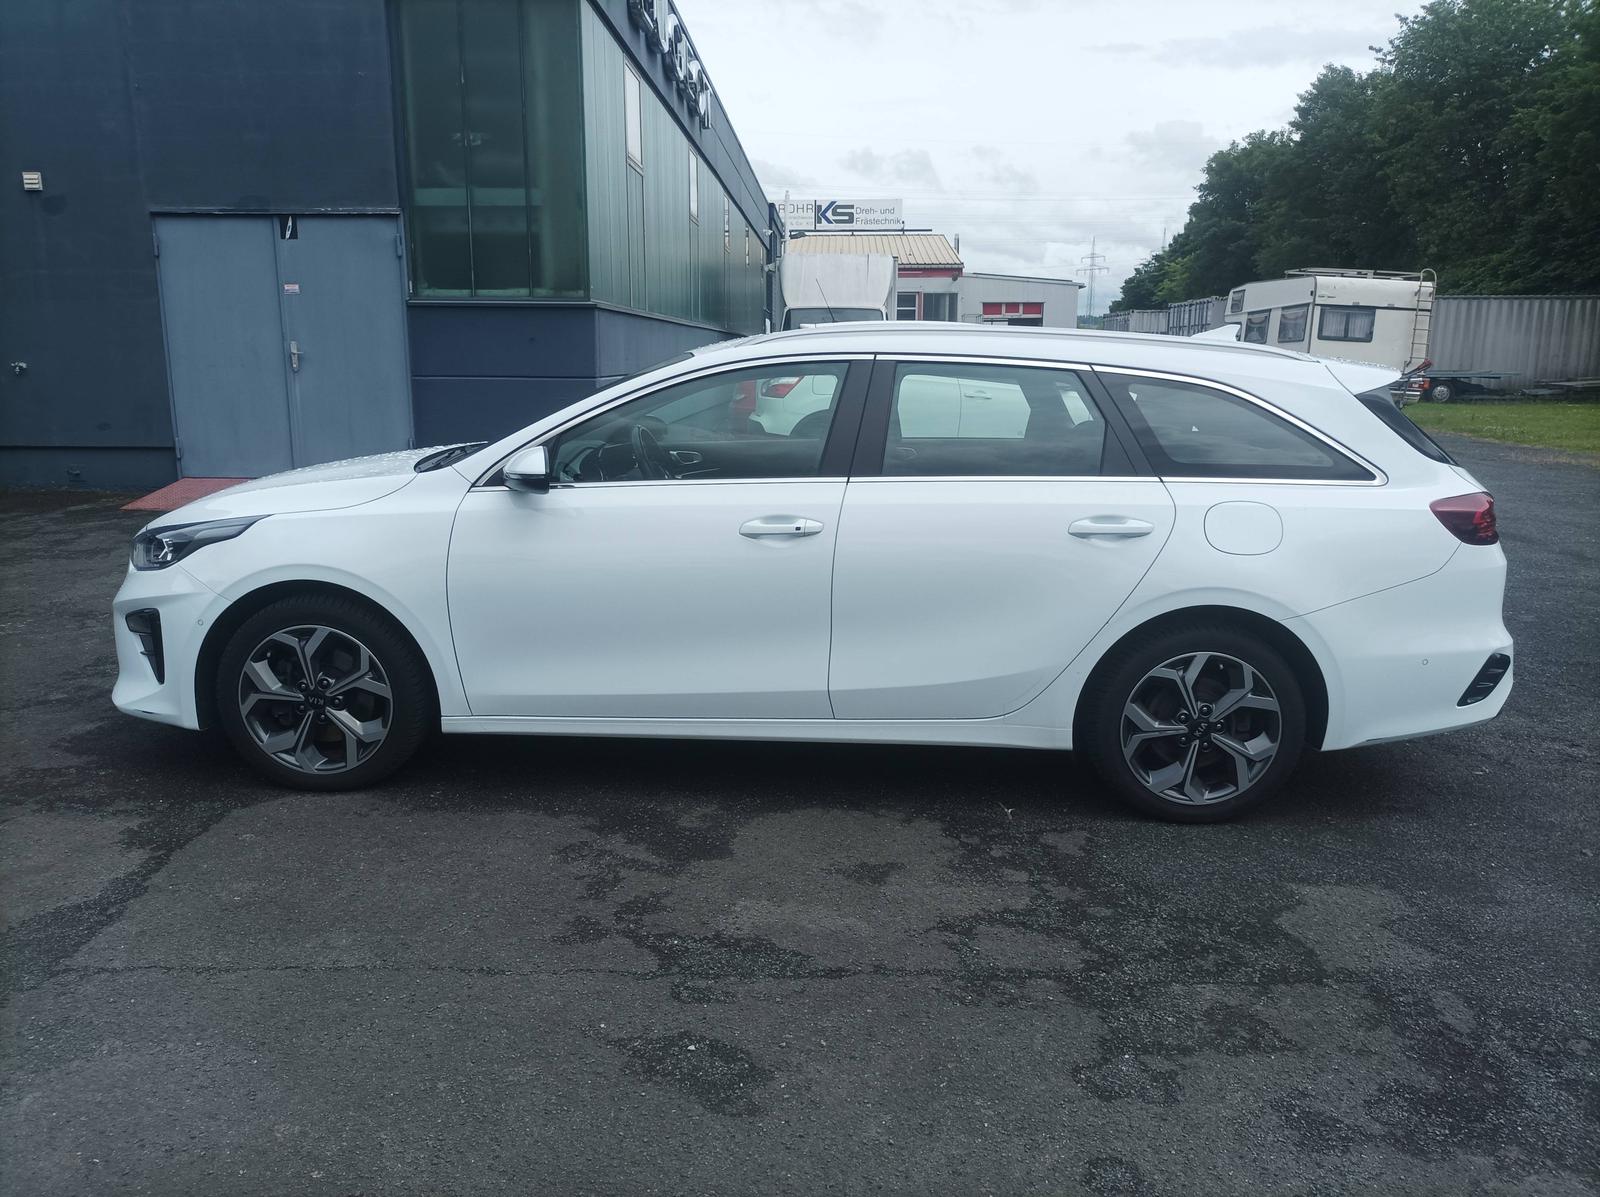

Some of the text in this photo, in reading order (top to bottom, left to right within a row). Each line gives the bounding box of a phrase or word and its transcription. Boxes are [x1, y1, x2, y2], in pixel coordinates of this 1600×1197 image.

[816, 200, 854, 224] KS
[855, 206, 895, 215] Dreh- und
[308, 696, 324, 705] KIA
[1193, 723, 1208, 737] KIA
